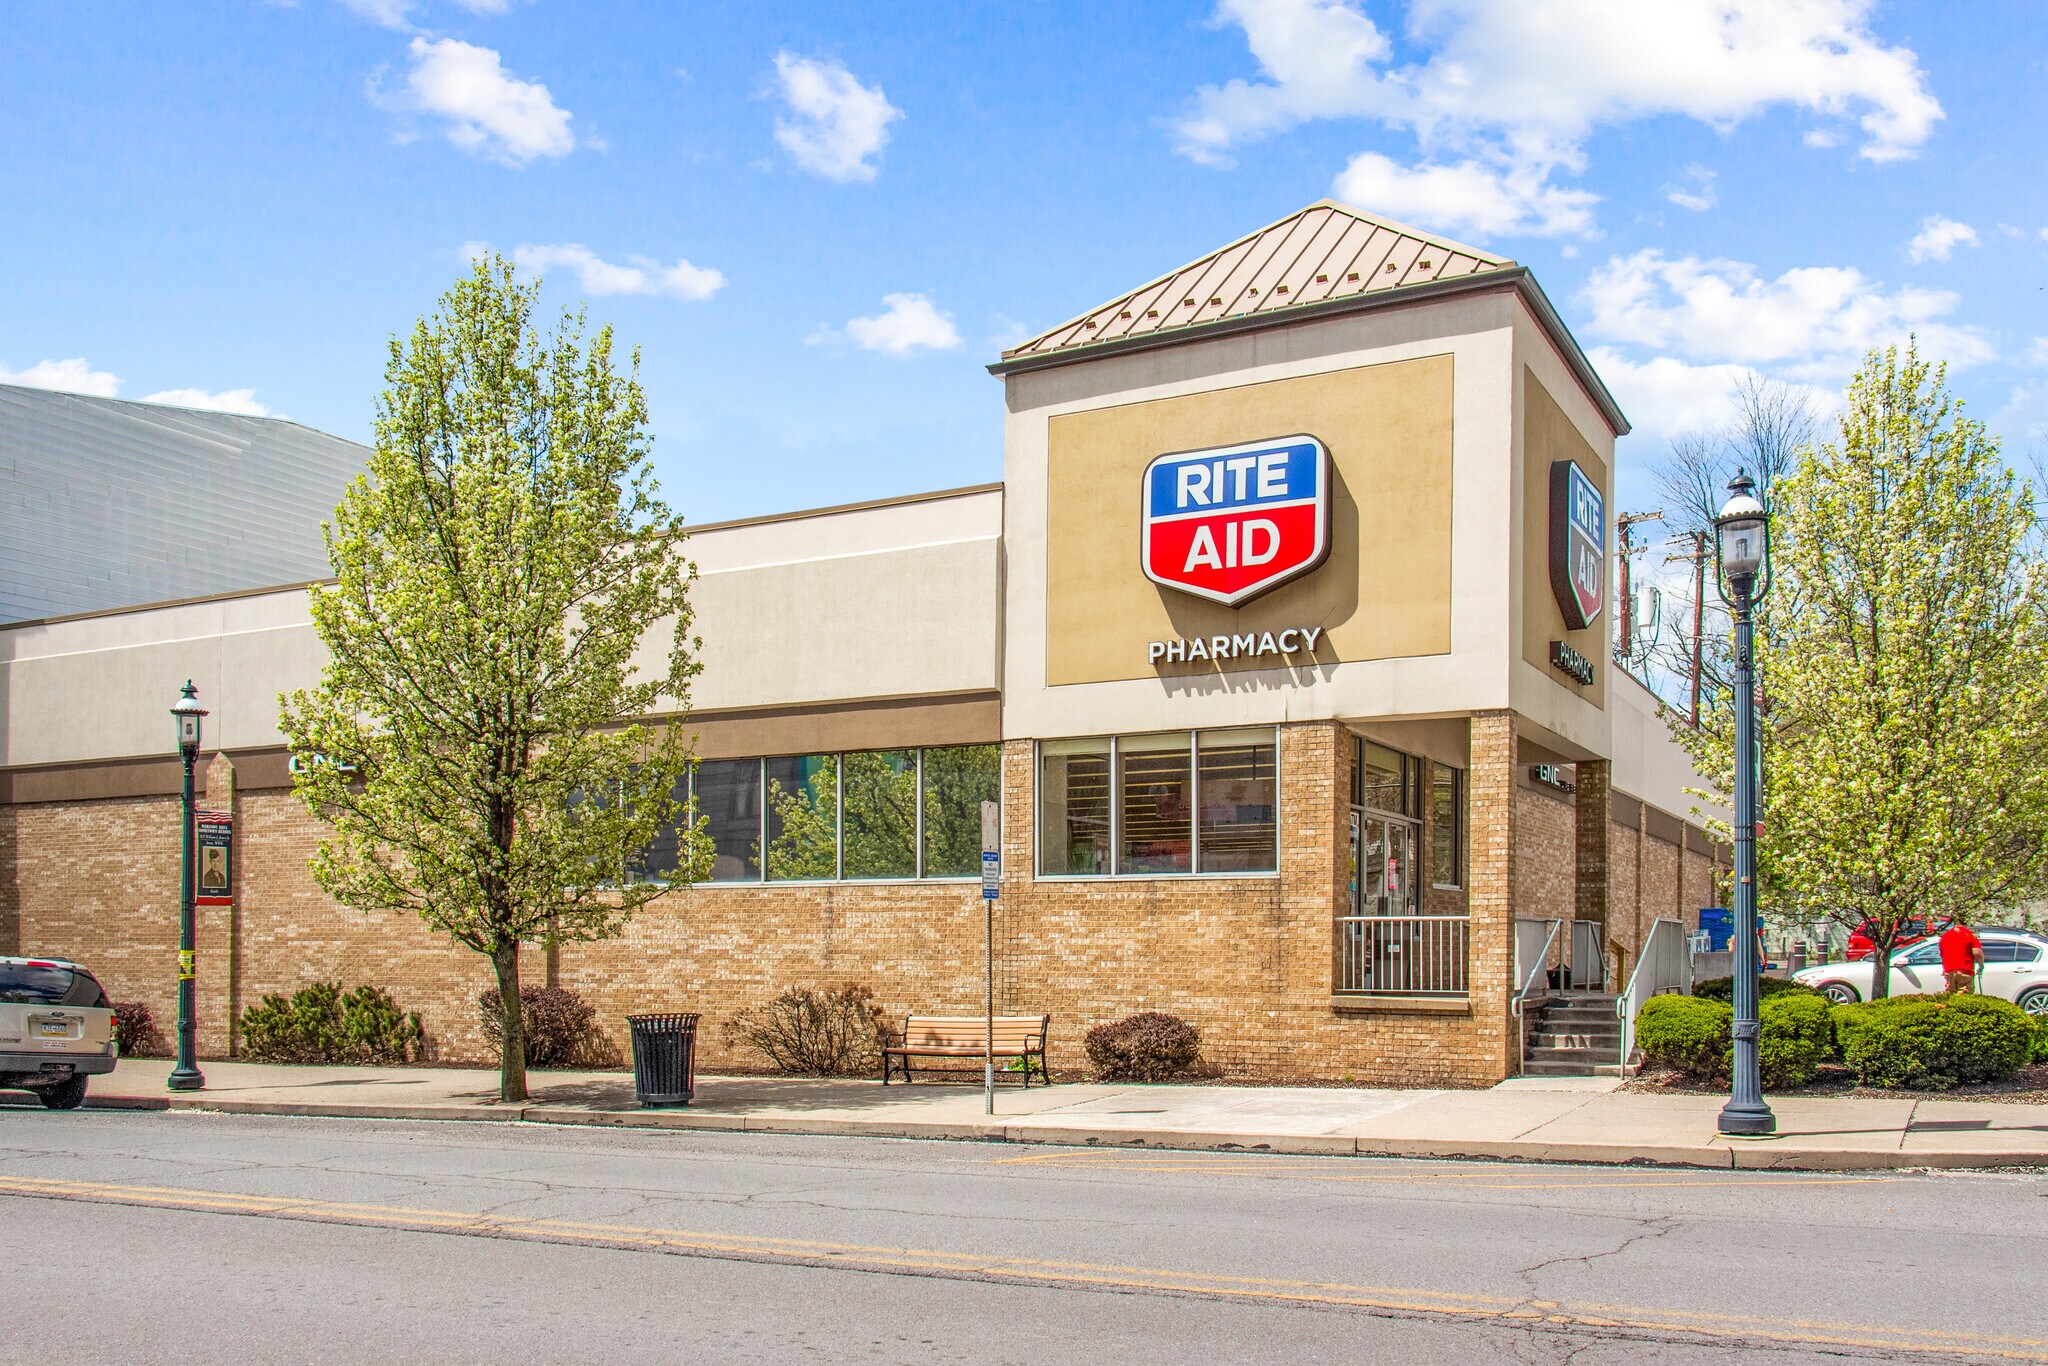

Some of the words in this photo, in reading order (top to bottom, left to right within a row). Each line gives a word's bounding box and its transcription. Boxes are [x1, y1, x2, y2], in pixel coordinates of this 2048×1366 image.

[1176, 452, 1289, 509] RITE
[1576, 479, 1599, 541] RITE
[1183, 518, 1281, 573] AID
[1577, 544, 1598, 599] AID
[1148, 626, 1323, 665] PHARMACY
[1560, 640, 1595, 684] PHARMACY
[1540, 764, 1560, 786] GNC
